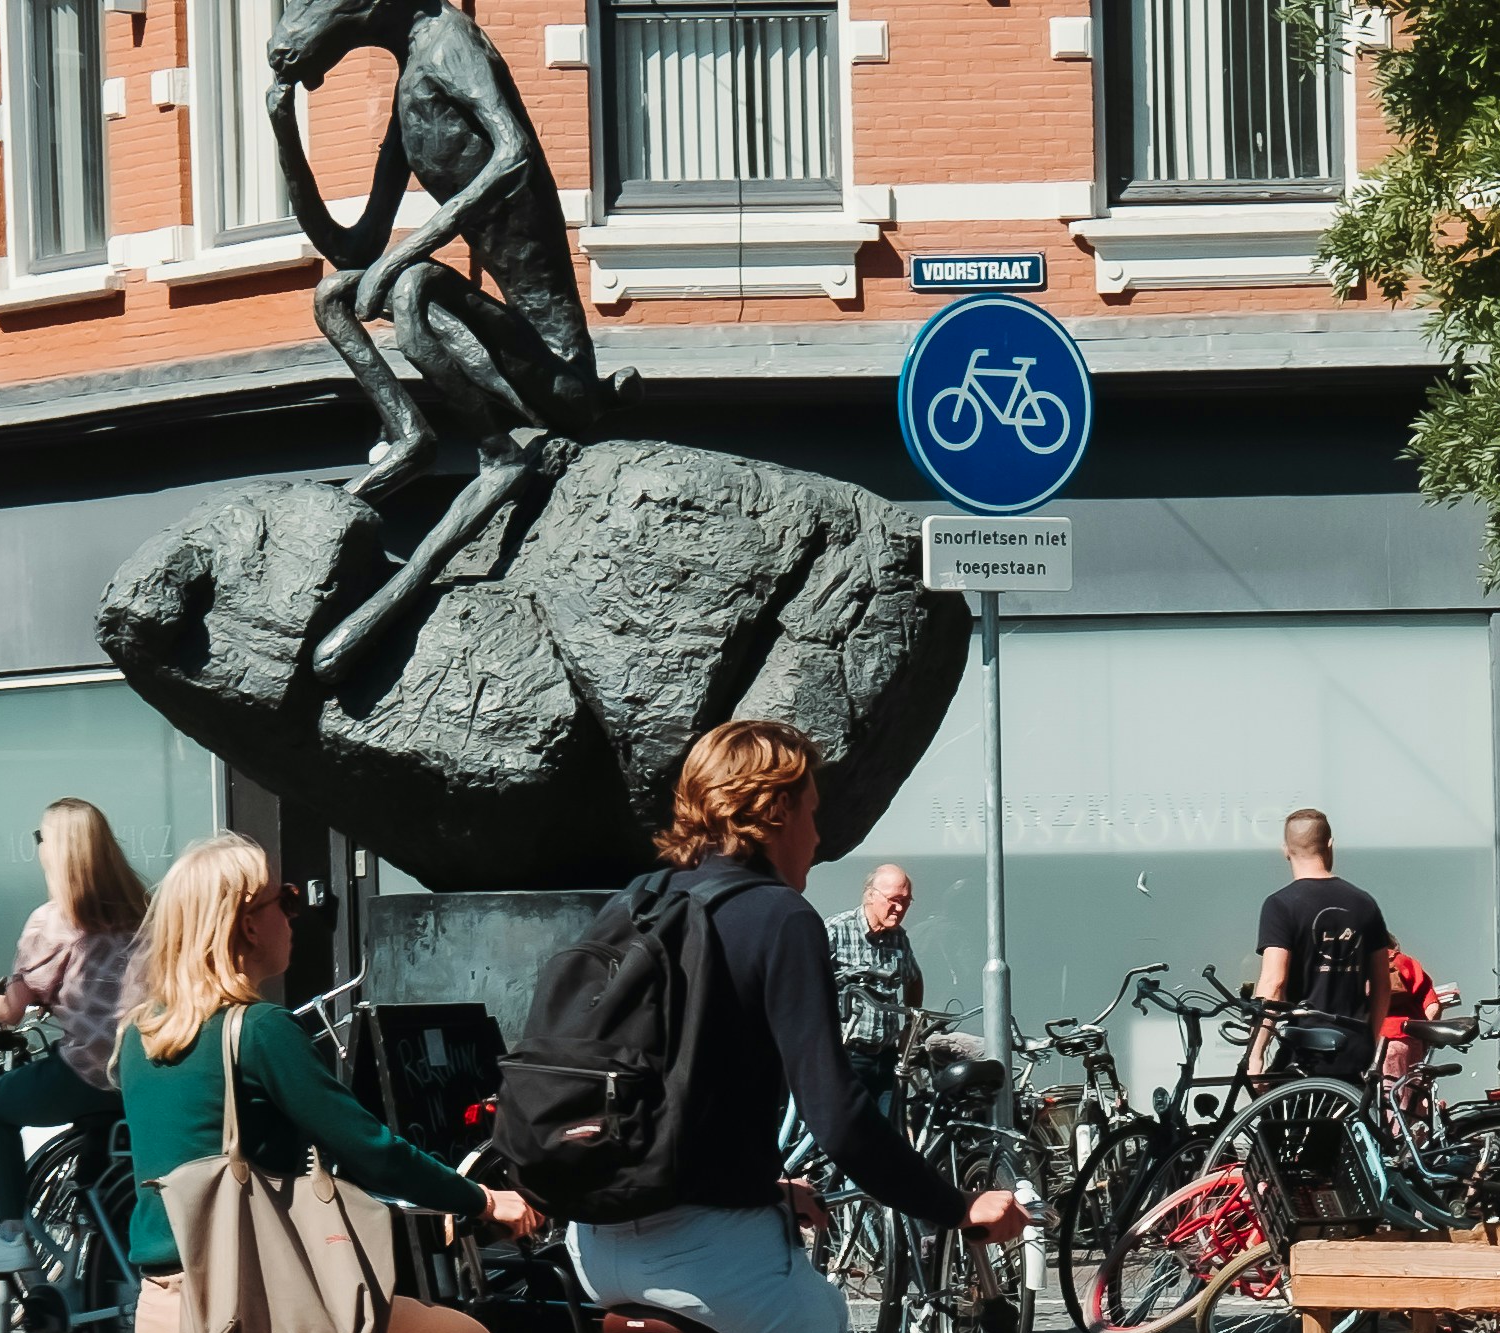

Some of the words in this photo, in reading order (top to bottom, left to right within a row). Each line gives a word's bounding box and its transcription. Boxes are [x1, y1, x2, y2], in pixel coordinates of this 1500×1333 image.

[921, 261, 1032, 281] VOORSTRAAT
[933, 530, 1028, 545] snorfietsen
[1034, 531, 1067, 546] niet
[955, 559, 1046, 579] toegestaan
